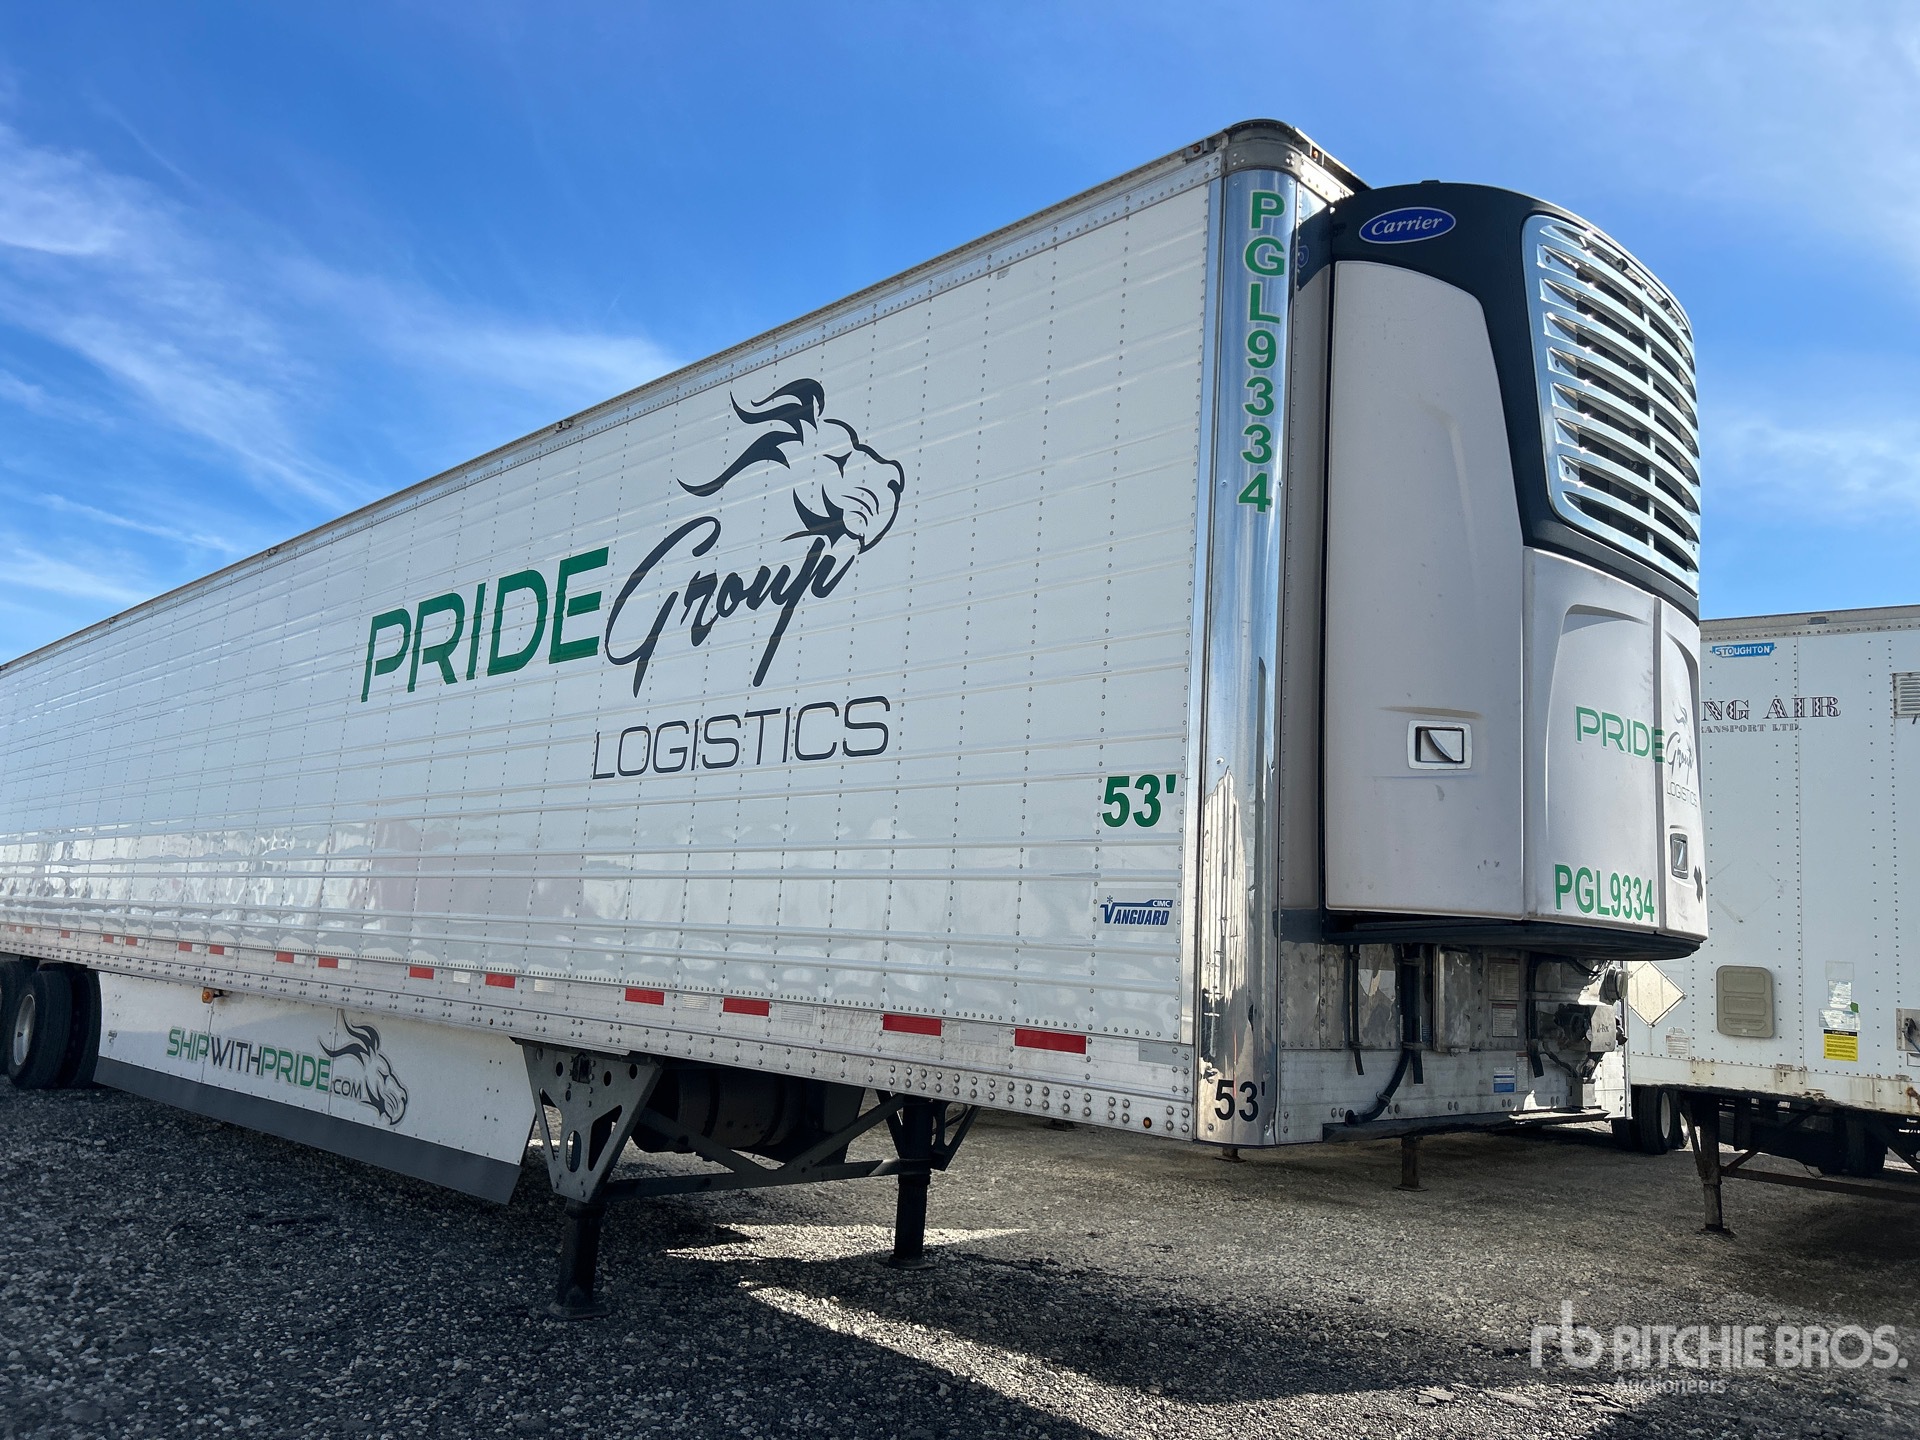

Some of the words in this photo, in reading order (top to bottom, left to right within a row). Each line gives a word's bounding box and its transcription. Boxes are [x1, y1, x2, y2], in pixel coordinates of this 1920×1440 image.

[1371, 216, 1443, 235] Carrier
[1238, 191, 1285, 512] PGL9334
[361, 546, 608, 702] PRIDE
[605, 516, 855, 697] Group
[1715, 646, 1771, 655] STOUGHTON
[1763, 696, 1841, 719] AIR
[1772, 723, 1802, 731] LTD.
[593, 696, 890, 779] LOGISTICS
[1576, 706, 1665, 763] PRIDE
[1102, 774, 1176, 827] 53'
[1100, 902, 1170, 925] VANGUARD
[1554, 864, 1655, 922] PGL9334
[1214, 1080, 1266, 1122] 53'
